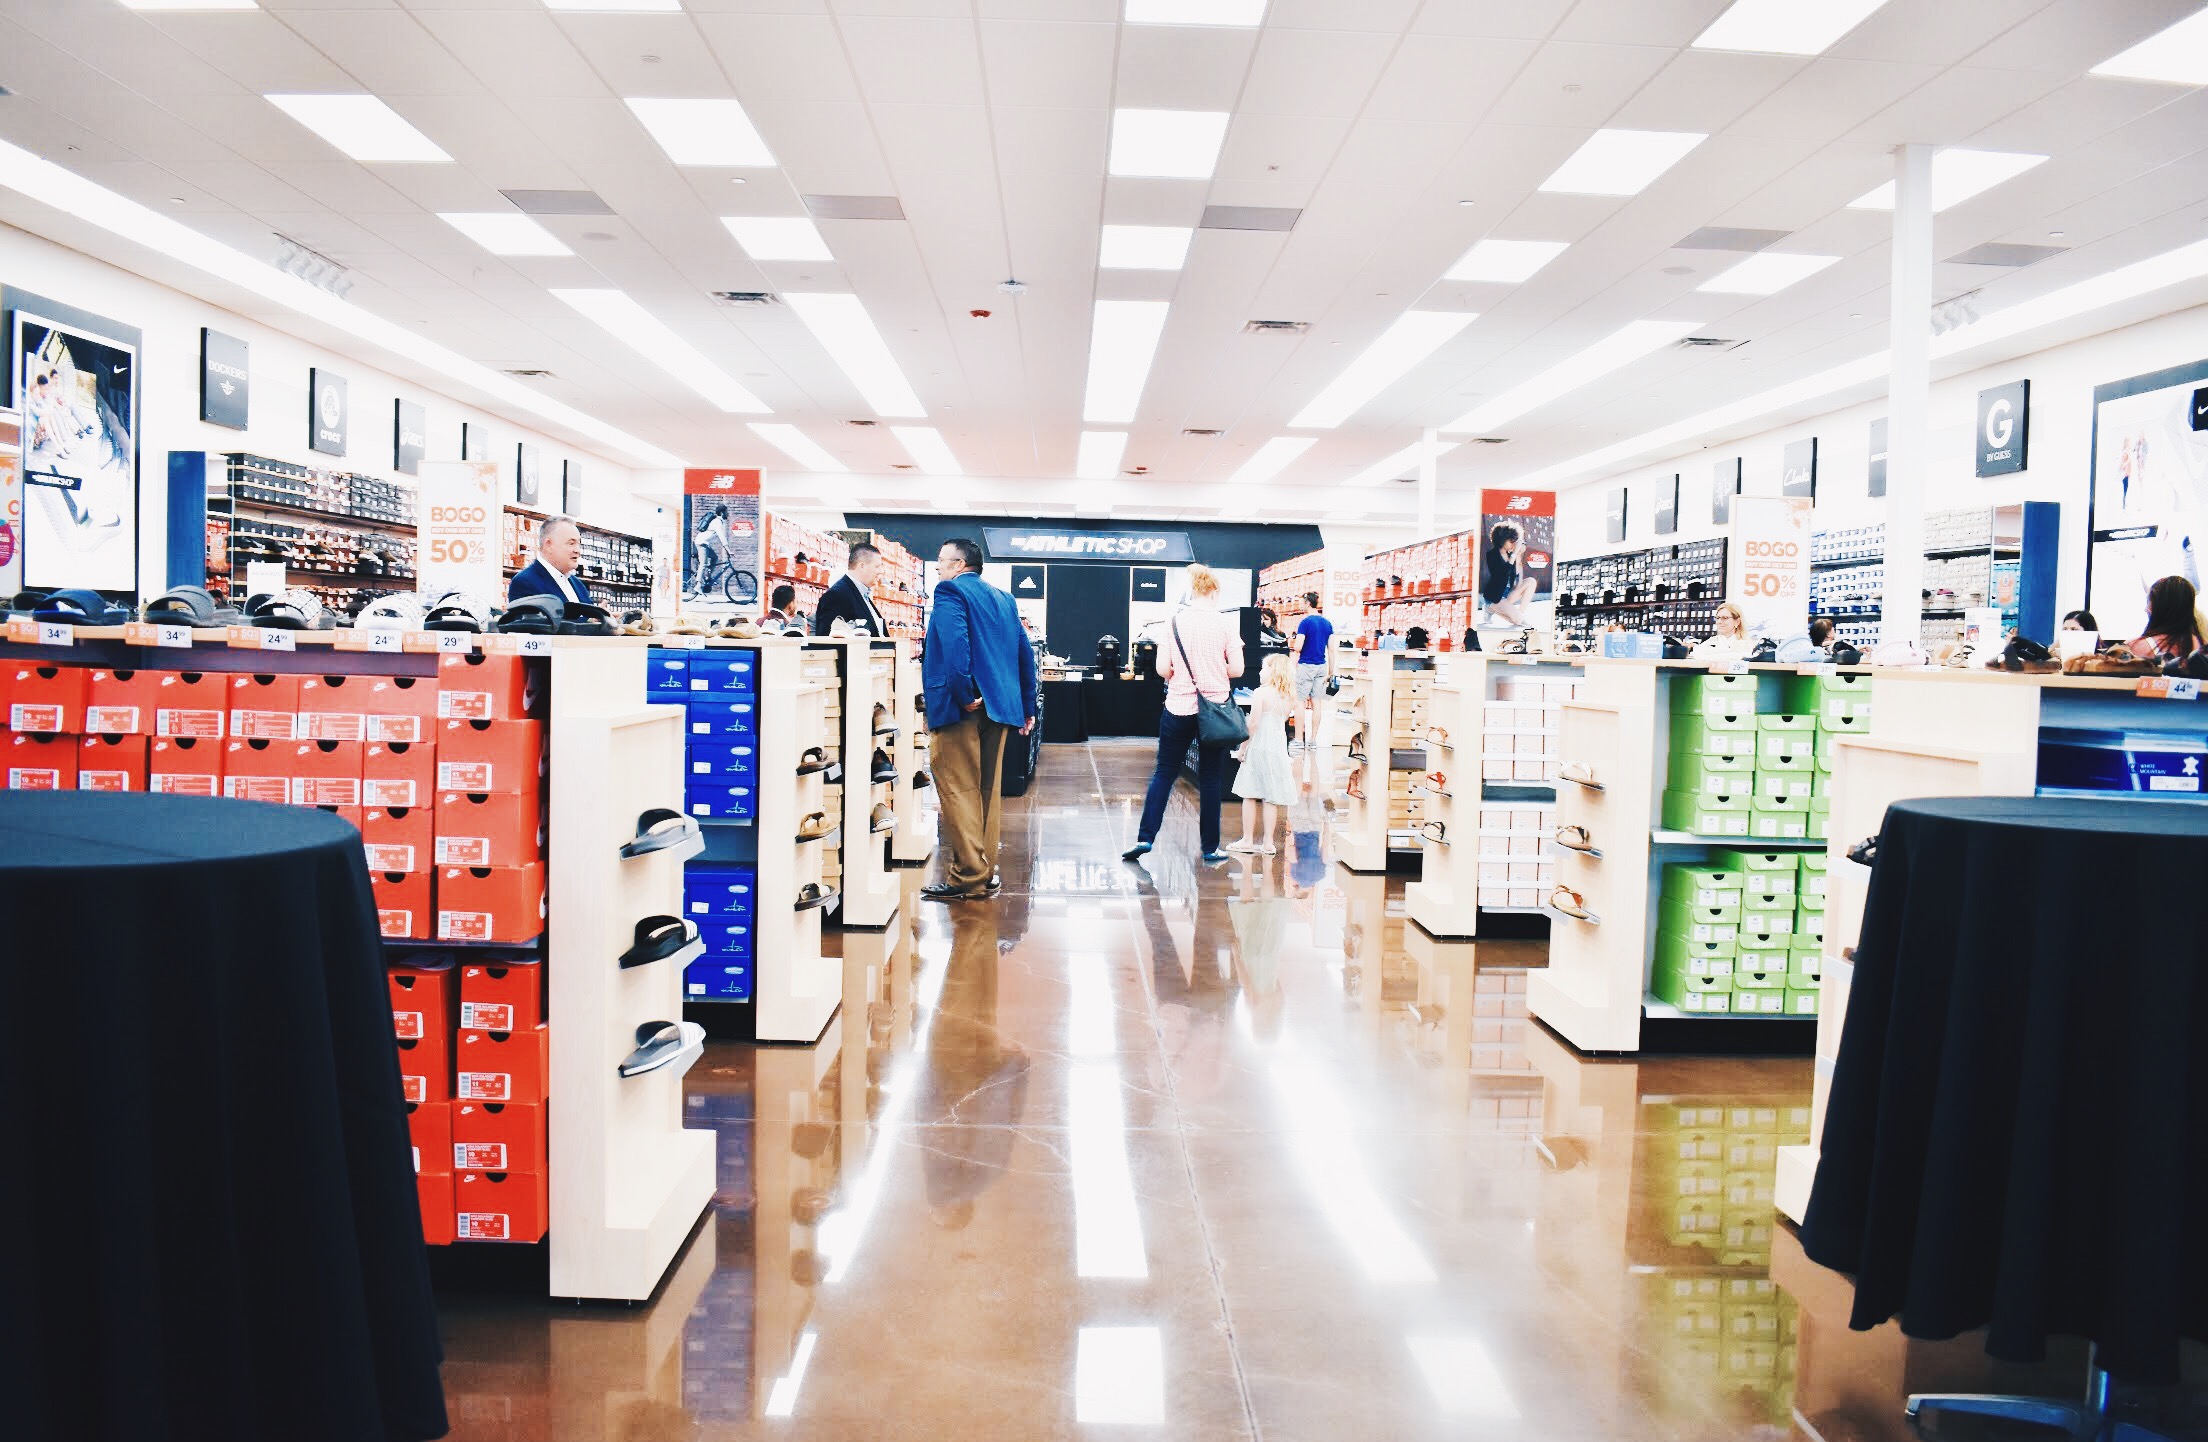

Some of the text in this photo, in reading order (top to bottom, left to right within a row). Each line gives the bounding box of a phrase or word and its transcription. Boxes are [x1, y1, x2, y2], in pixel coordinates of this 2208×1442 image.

[209, 360, 247, 380] DOCKERS
[1986, 398, 2013, 449] G
[320, 429, 342, 444] crocs
[1993, 449, 2011, 461] GUESS
[431, 506, 486, 522] BOGO
[1745, 541, 1798, 557] BOGO
[1334, 571, 1360, 581] BOG
